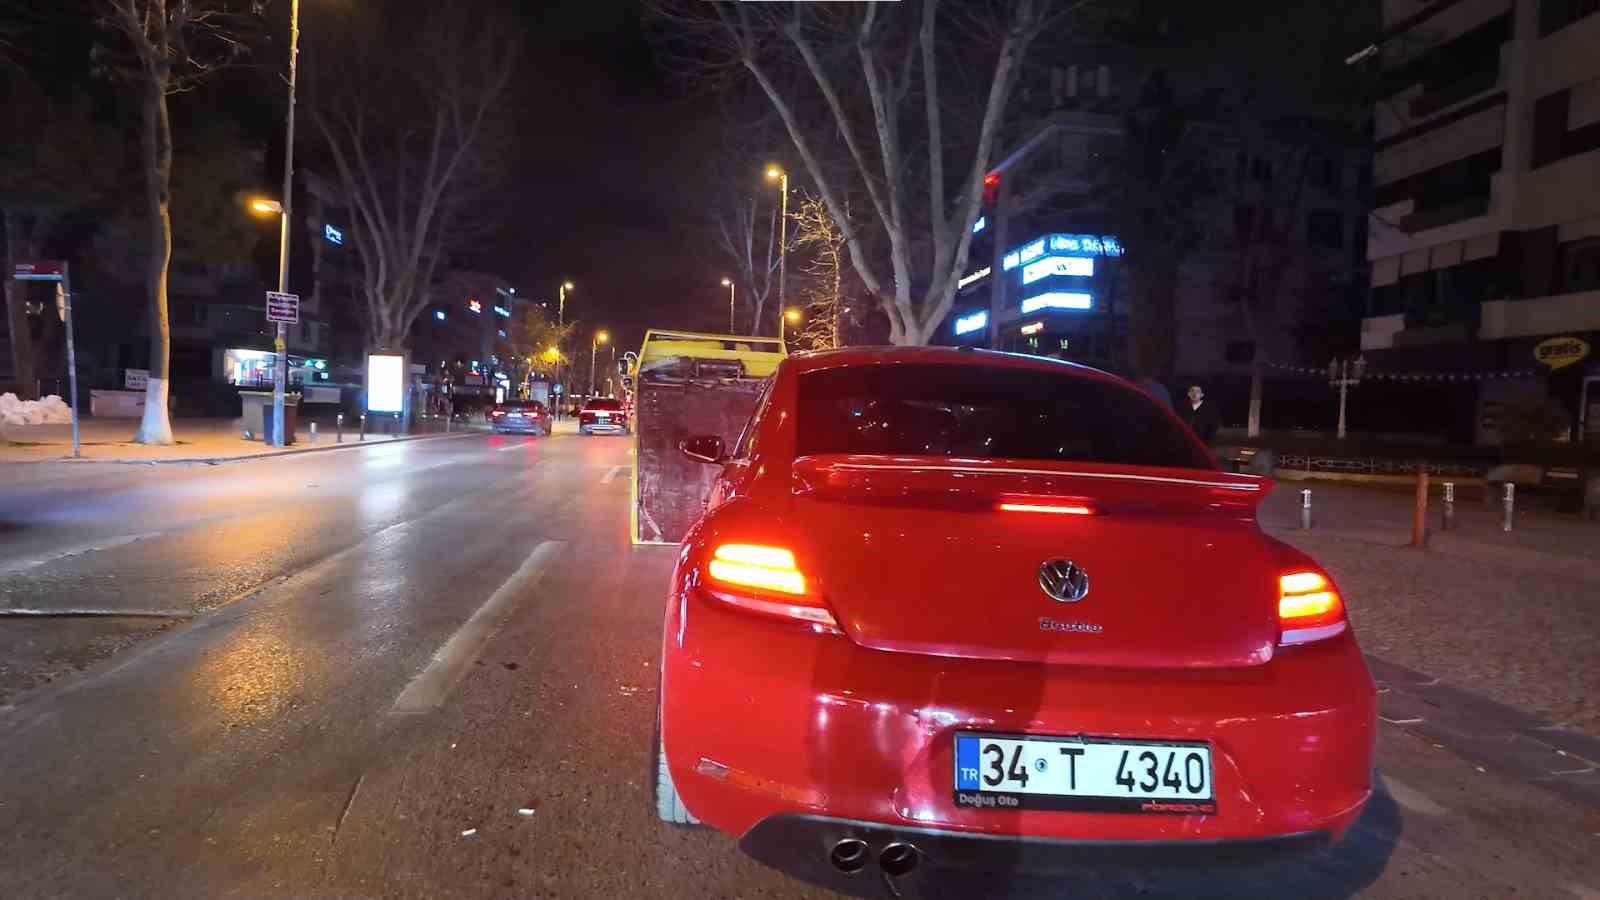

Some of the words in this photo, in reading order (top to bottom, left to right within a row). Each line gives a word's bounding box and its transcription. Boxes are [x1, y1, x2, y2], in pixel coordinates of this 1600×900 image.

[1540, 341, 1583, 360] gratis
[961, 768, 978, 781] TR
[982, 743, 1029, 788] 34
[1060, 747, 1085, 790] T
[1115, 749, 1205, 794] 4340
[960, 793, 996, 808] Doğuş
[998, 795, 1019, 807] Oto
